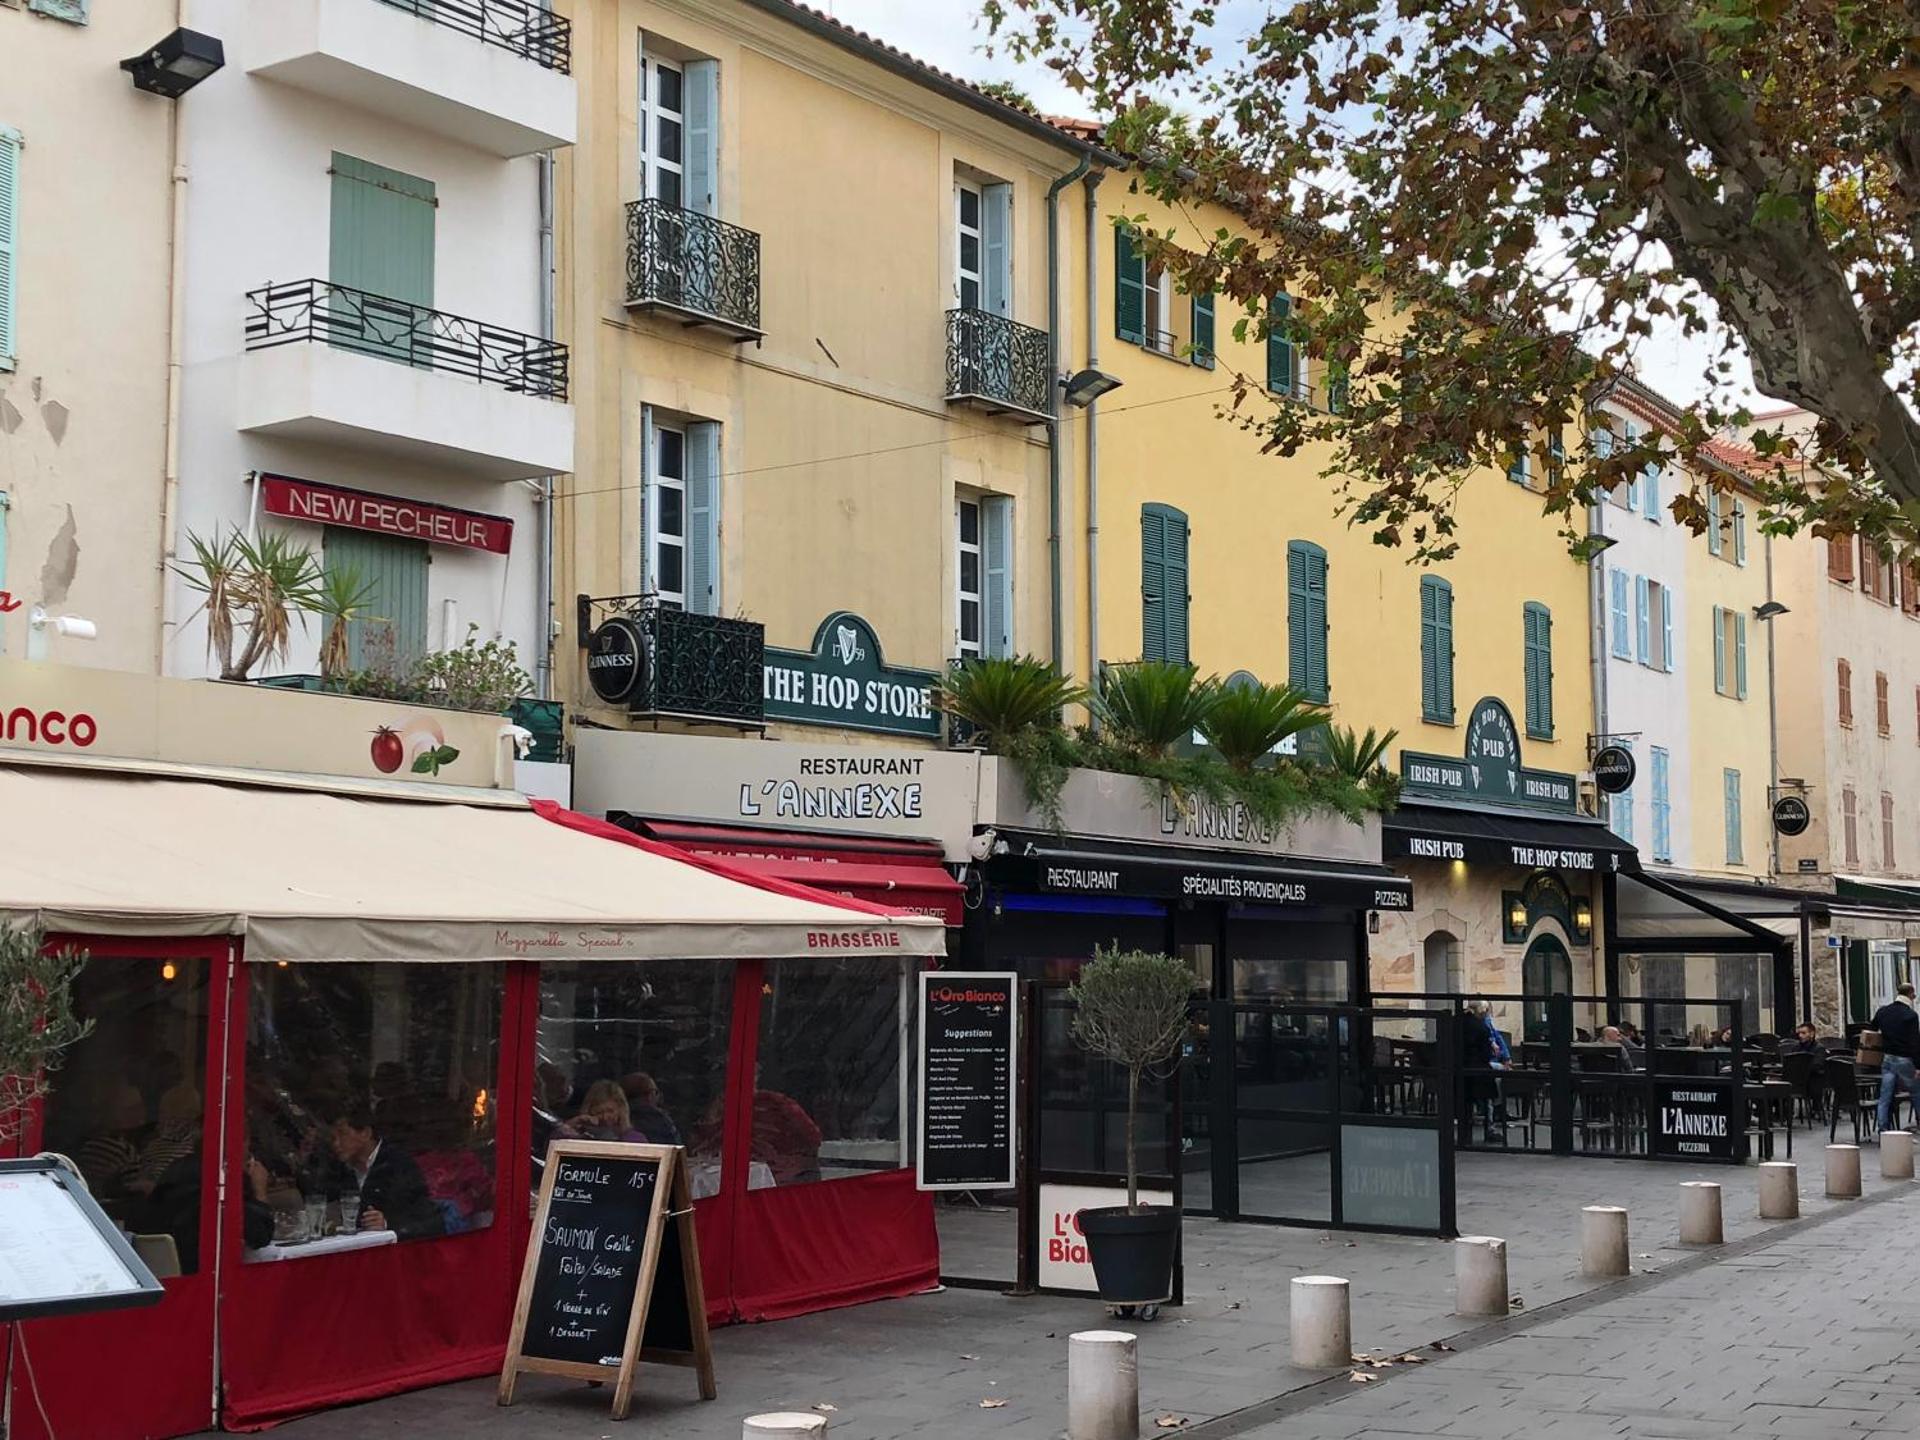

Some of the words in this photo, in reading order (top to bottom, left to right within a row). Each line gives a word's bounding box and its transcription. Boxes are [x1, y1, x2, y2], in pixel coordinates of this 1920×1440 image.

[290, 489, 355, 521] NEW
[361, 502, 487, 546] PECHEUR
[763, 666, 805, 704] THE
[811, 672, 860, 710] HOP
[864, 680, 932, 719] STORE
[0, 707, 97, 747] nco
[1481, 708, 1497, 726] HOP
[1482, 738, 1505, 758] PUB
[800, 758, 924, 775] RESTAURANT
[1410, 765, 1439, 784] IRISH
[1441, 768, 1463, 787] PUB
[740, 779, 922, 818] L'ANNEXE
[1526, 780, 1550, 797] IRISH
[1552, 784, 1570, 800] PUB
[1410, 838, 1440, 857] IRISH
[1442, 841, 1464, 859] PUB
[1511, 846, 1535, 866] THE
[1536, 849, 1559, 867] HOP
[1560, 851, 1595, 870] STORE
[1047, 867, 1119, 890] RESTAURANT
[1183, 873, 1241, 896] SPÉCIALITÉS
[1243, 880, 1306, 903] PROVENÇALES
[1375, 890, 1408, 907] PIZZERIA
[807, 931, 900, 948] BRASSERIE
[944, 1028, 992, 1039] Suggestions
[1672, 1091, 1718, 1102] RESTAURANT
[1678, 1142, 1710, 1153] PIZZERIA
[559, 1163, 610, 1185] FORMULE
[545, 1216, 600, 1251] SAUMON
[1048, 1238, 1092, 1264] Bia
